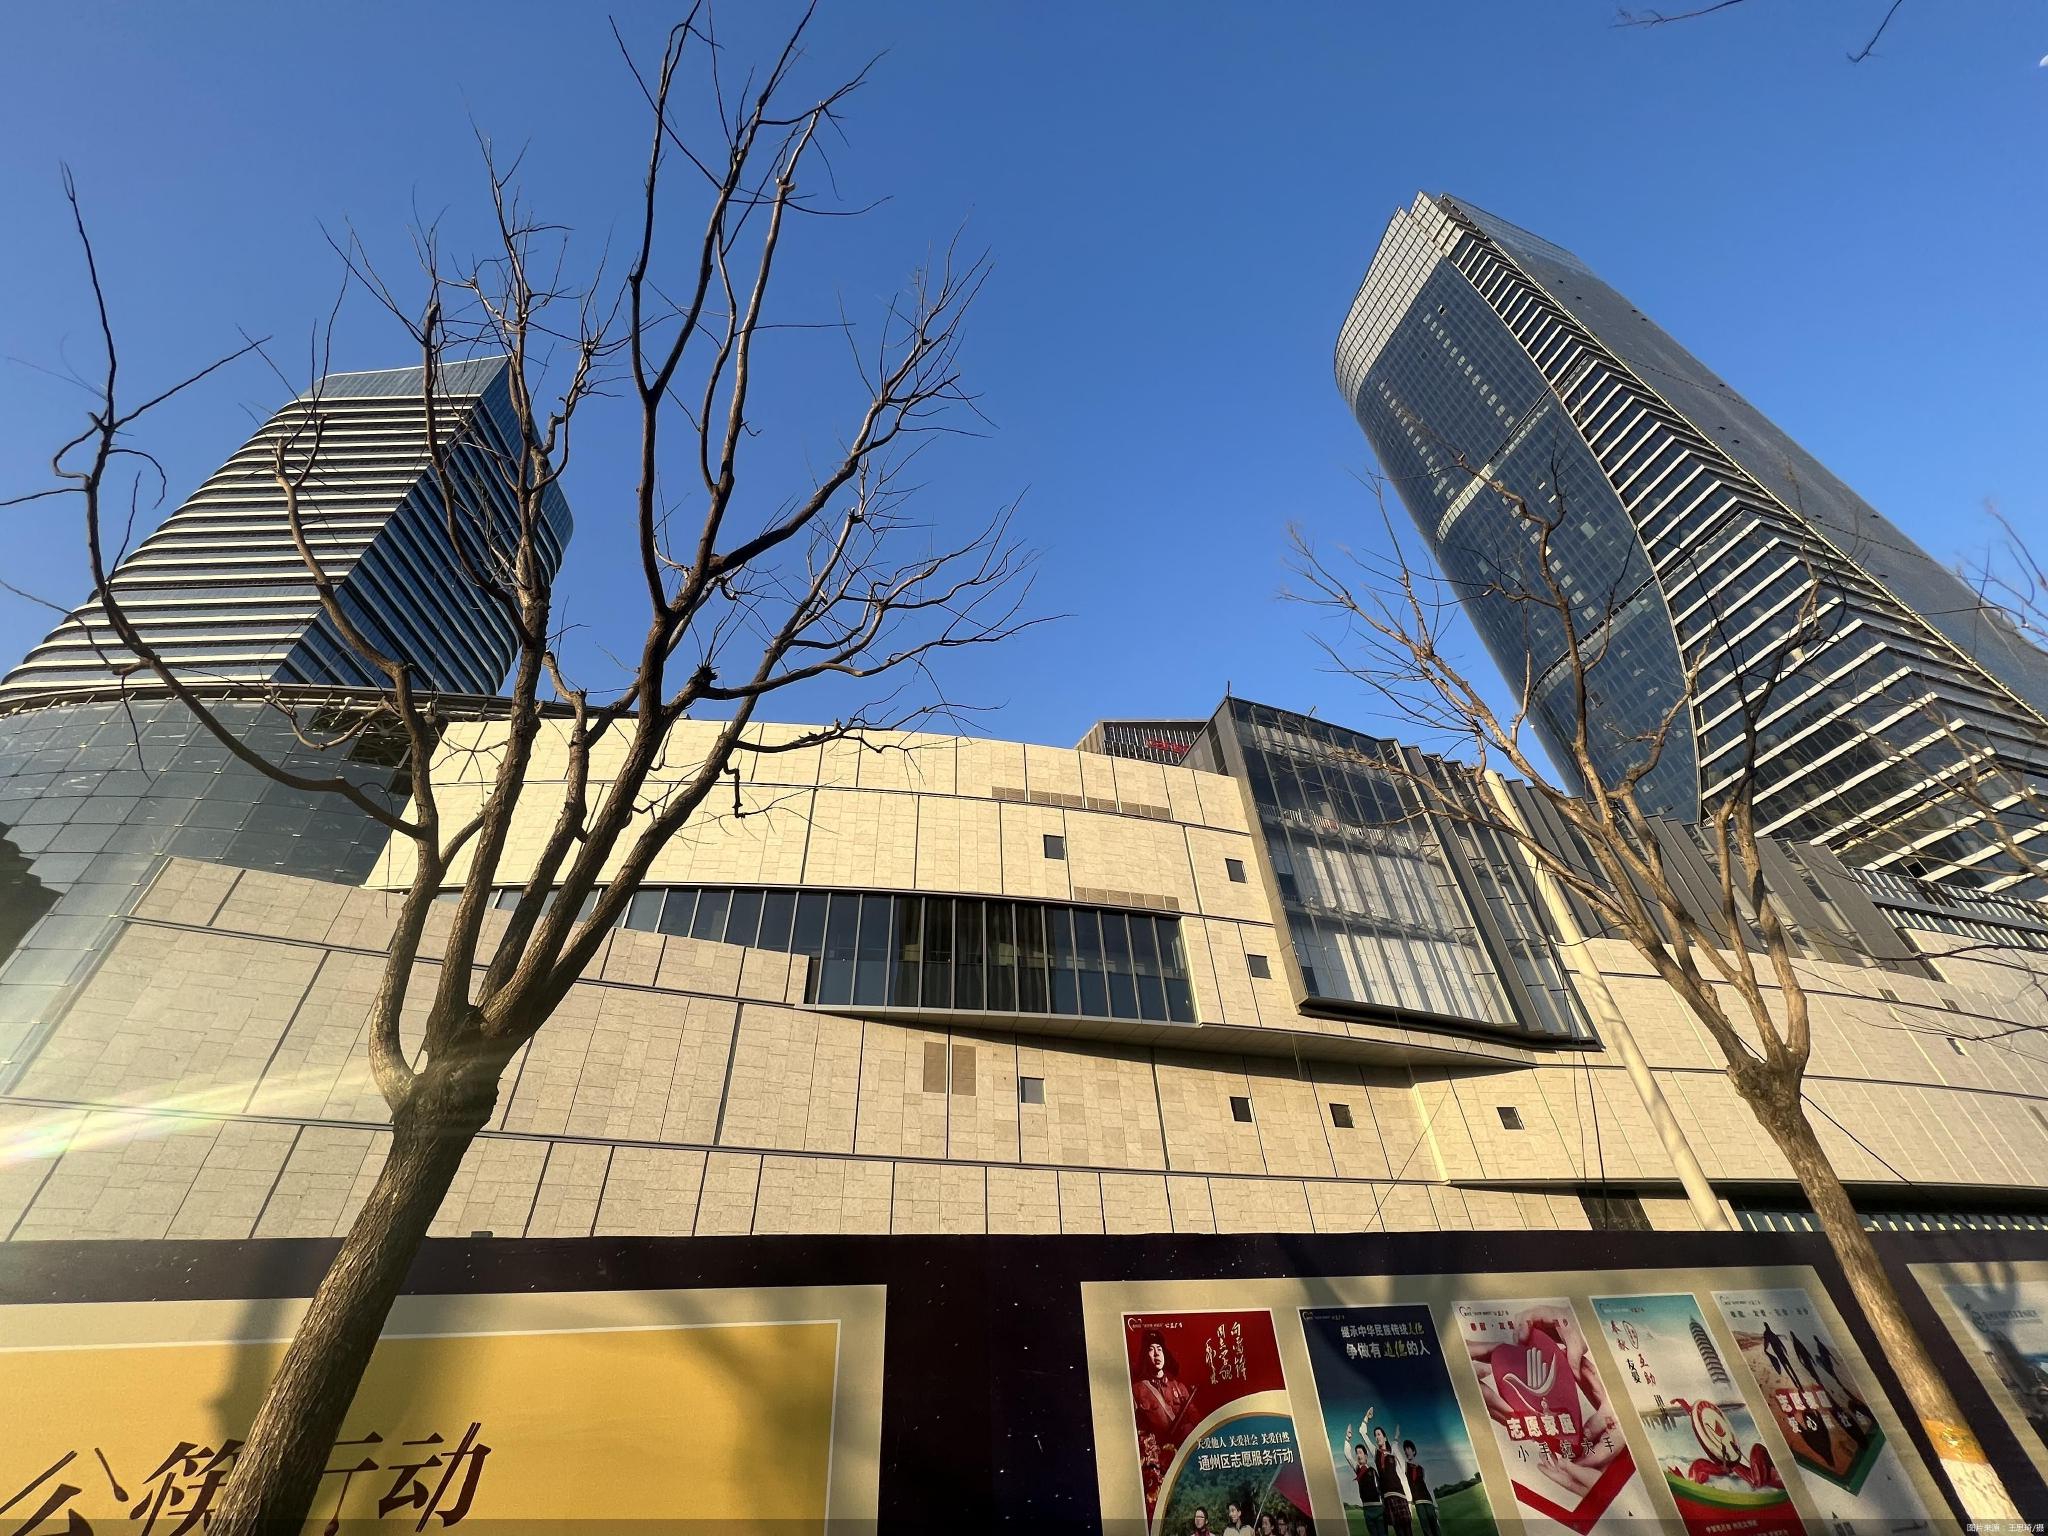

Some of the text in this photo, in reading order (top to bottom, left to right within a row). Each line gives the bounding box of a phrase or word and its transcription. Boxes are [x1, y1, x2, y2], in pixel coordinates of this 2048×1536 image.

[1346, 1339, 1431, 1360] 争做有道德的人
[1197, 1431, 1291, 1450] 关爱他人 关爱社会 关爱自然
[1198, 1447, 1294, 1471] 通州区志愿服务行动
